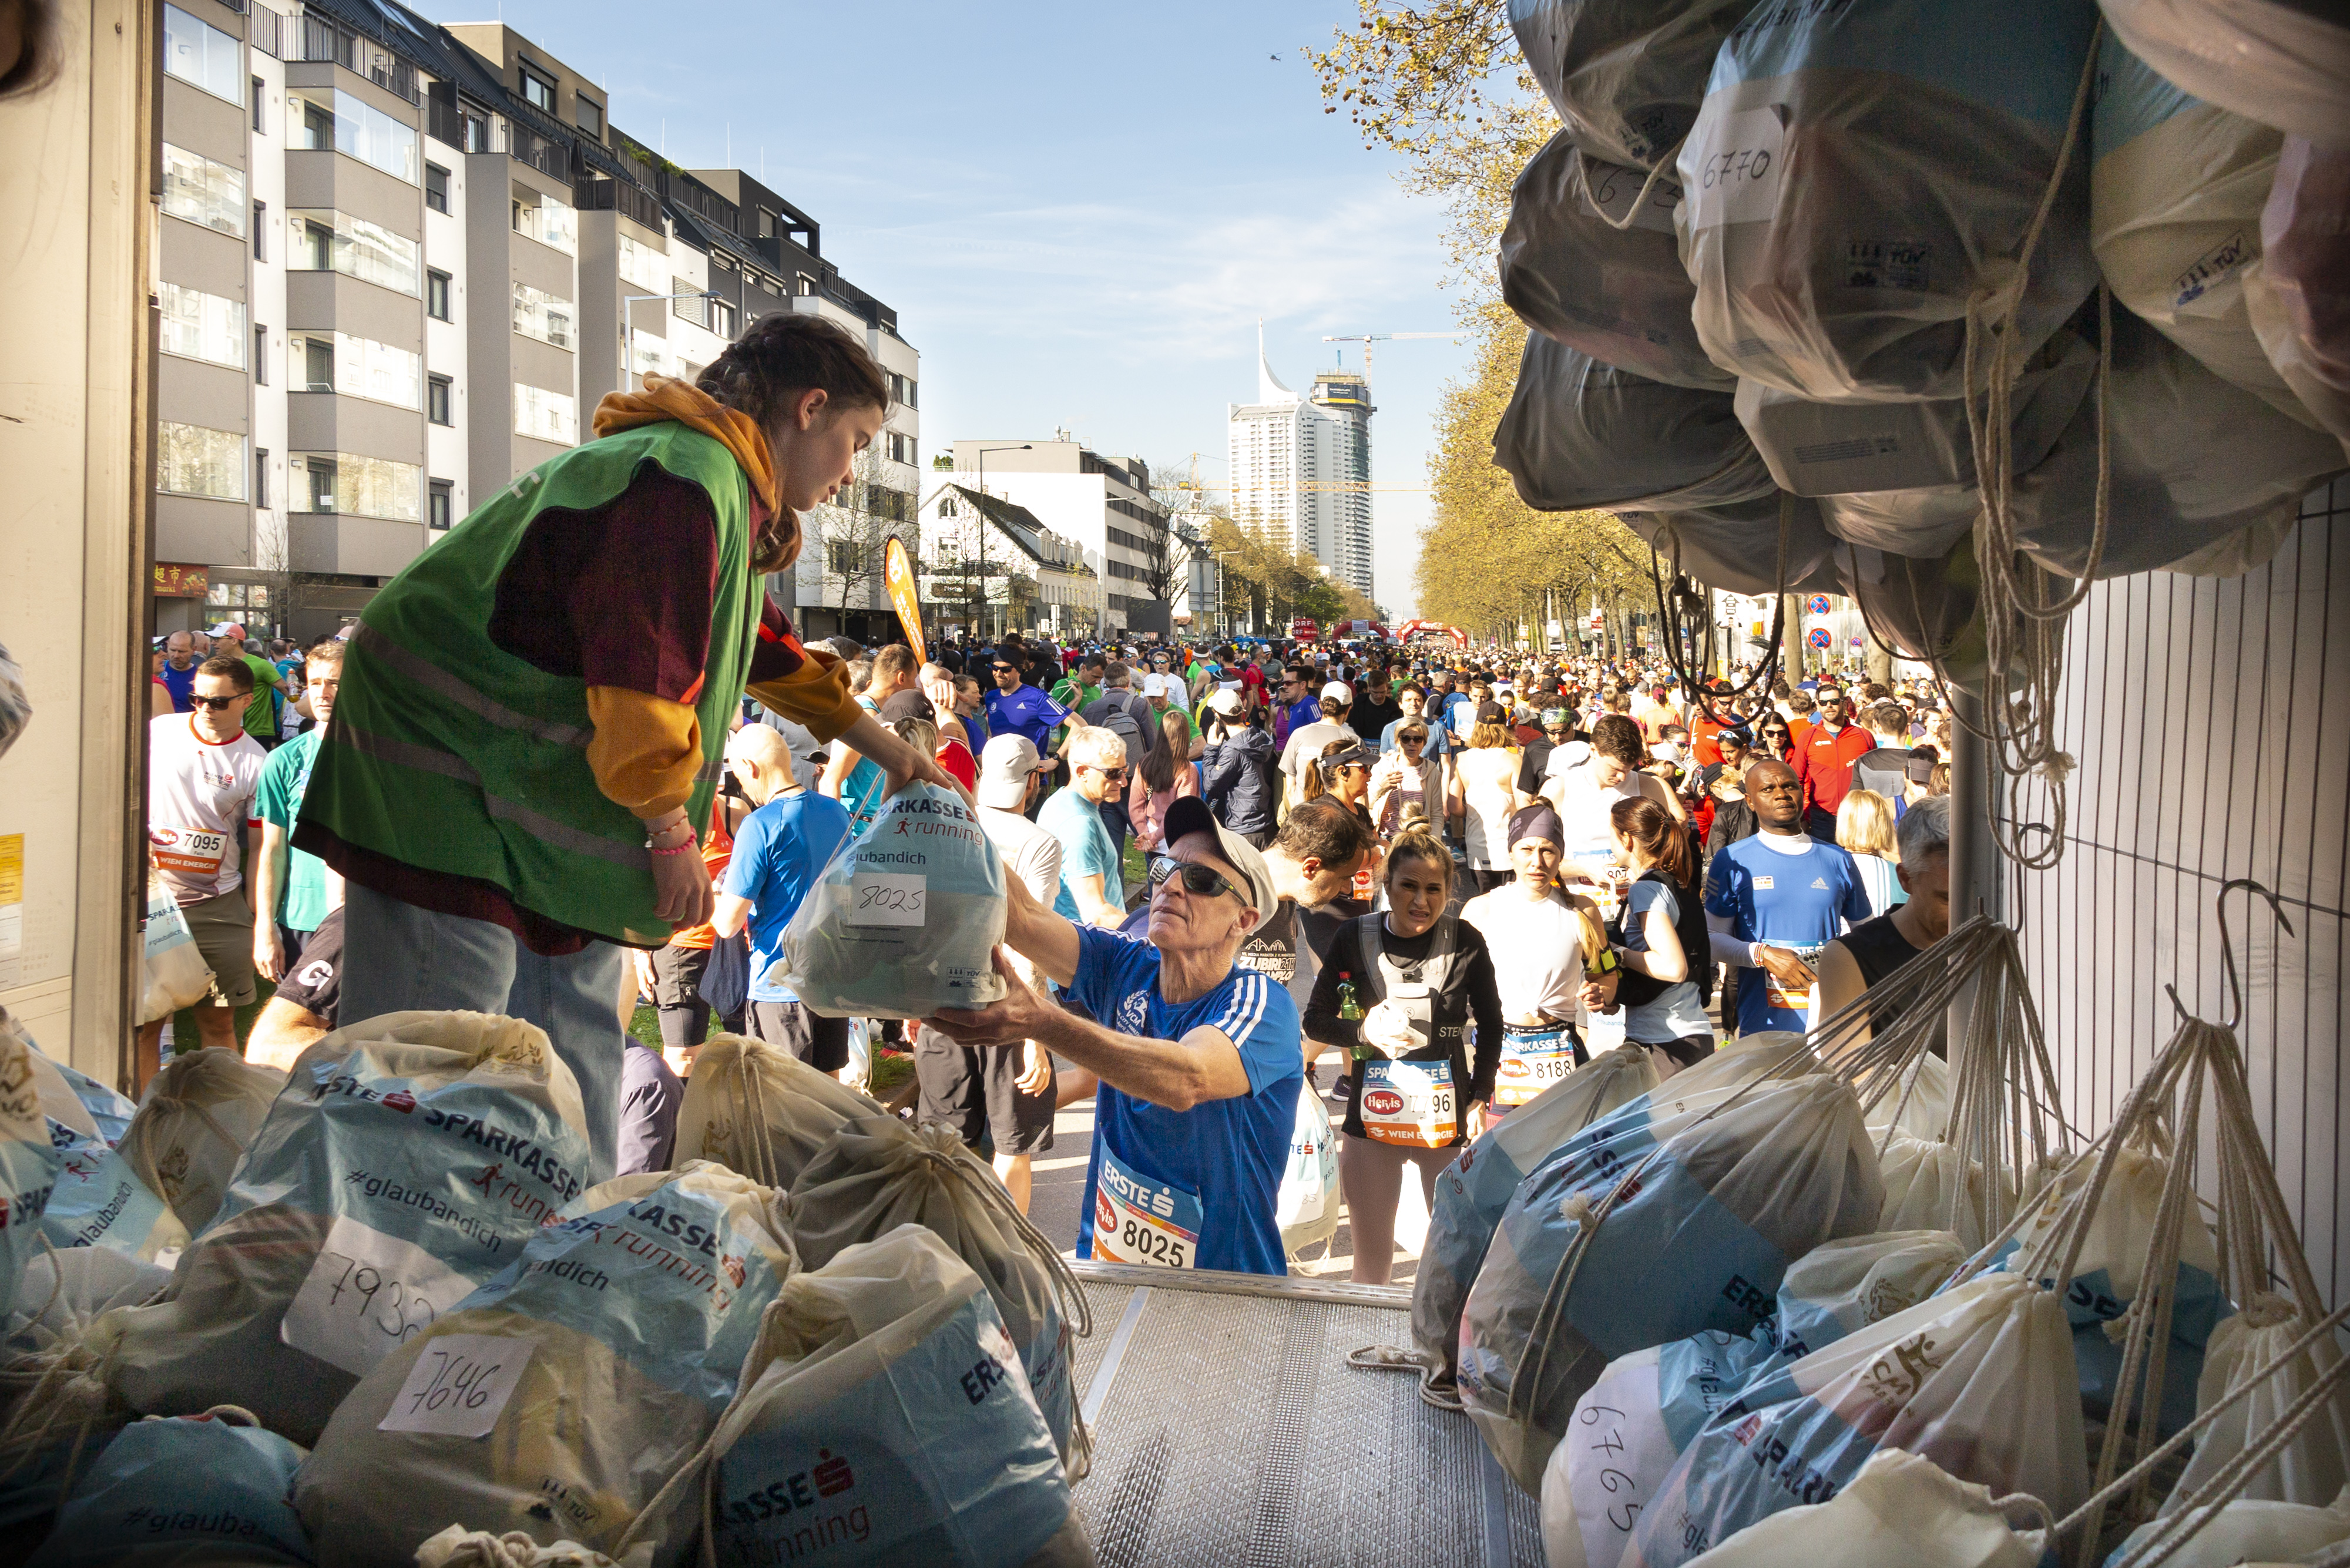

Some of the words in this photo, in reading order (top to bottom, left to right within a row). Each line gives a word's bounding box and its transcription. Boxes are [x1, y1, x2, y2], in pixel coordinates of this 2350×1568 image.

[1704, 150, 1771, 189] 6770
[184, 834, 220, 851] 7095
[915, 822, 983, 845] running
[160, 857, 182, 865] WIEN
[183, 859, 216, 869] ENERGIE
[860, 886, 924, 912] 8025
[1238, 956, 1282, 971] ZUBIRI
[1126, 1010, 1141, 1026] VCM
[1536, 1060, 1572, 1079] 8188
[1368, 1096, 1401, 1110] Hervis
[1409, 1094, 1451, 1113] 7796
[1388, 1130, 1415, 1139] WIEN
[1417, 1130, 1455, 1140] EERGIE
[425, 1108, 581, 1203] SPARKASSE
[1104, 1160, 1151, 1207] ERSTE
[344, 1169, 502, 1253] #glaubandich
[1123, 1220, 1184, 1267] 8025
[410, 1352, 501, 1415] 7646
